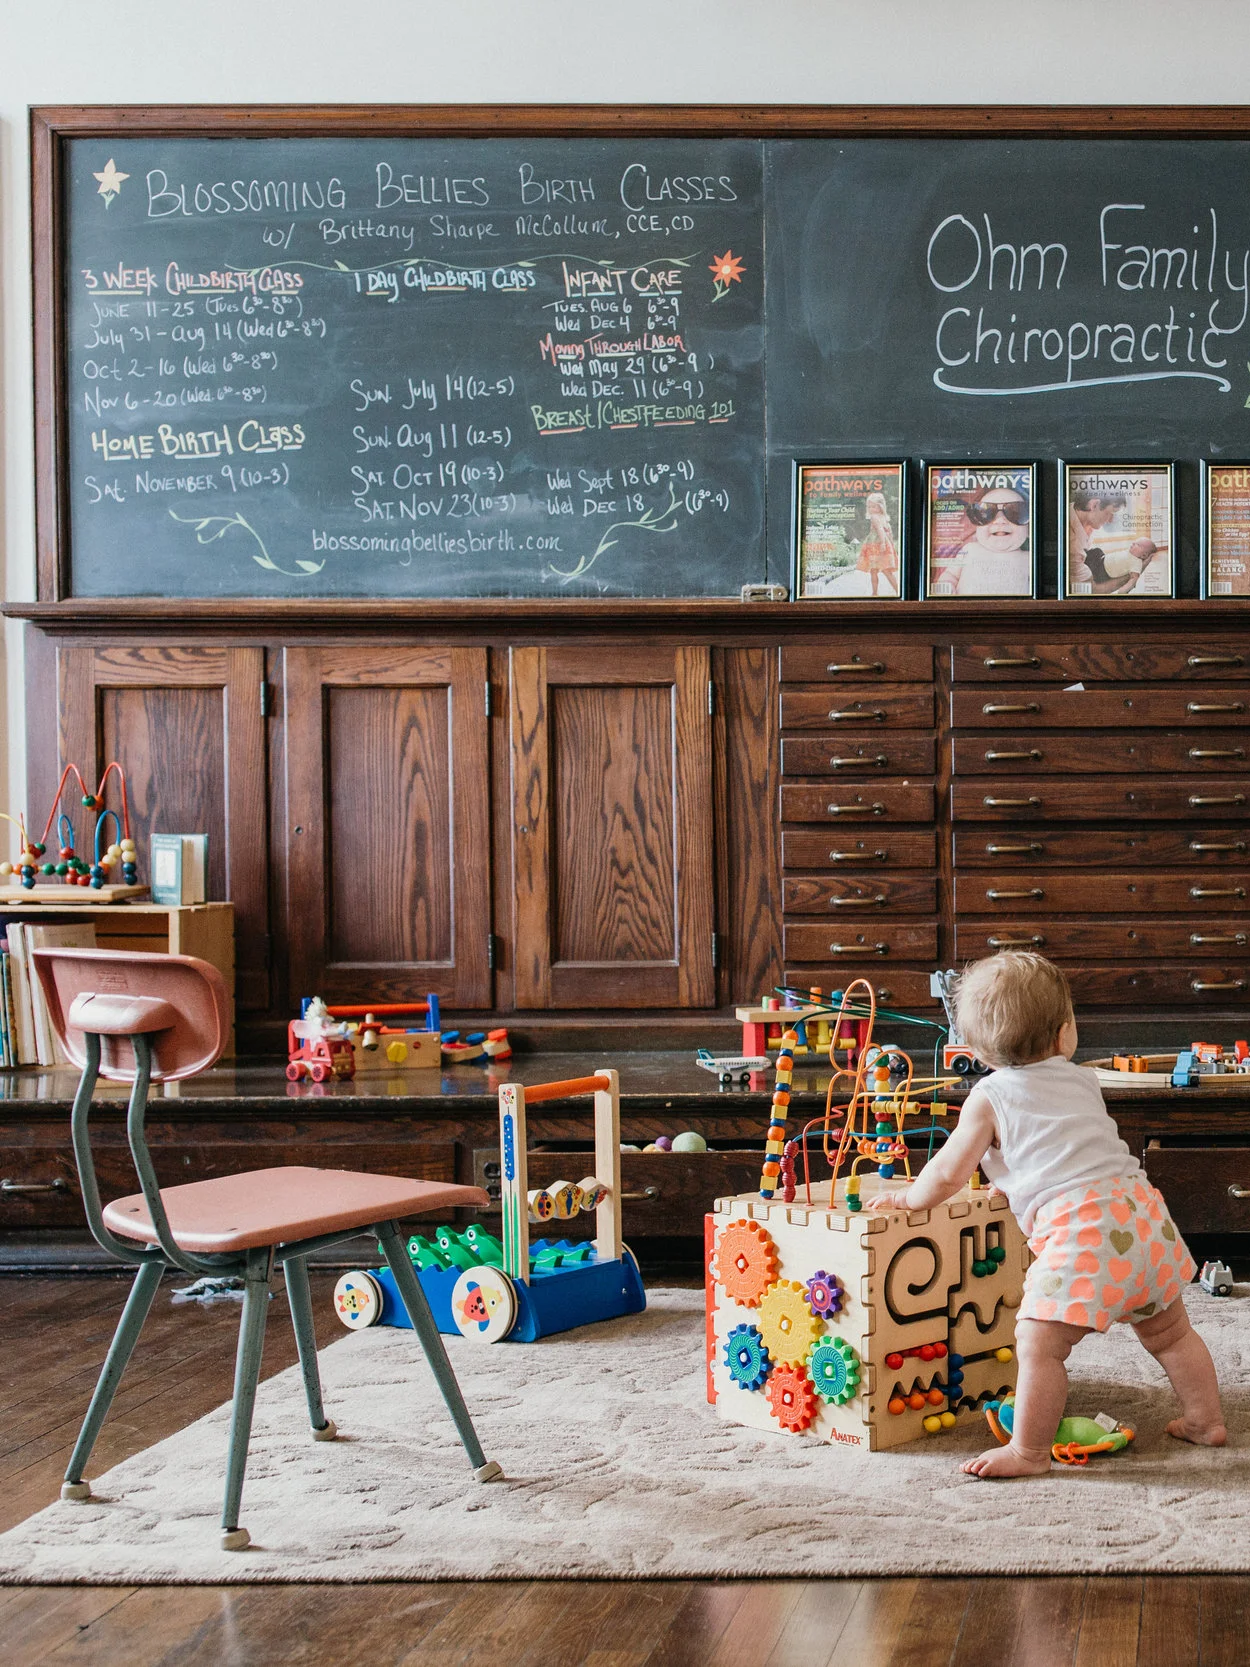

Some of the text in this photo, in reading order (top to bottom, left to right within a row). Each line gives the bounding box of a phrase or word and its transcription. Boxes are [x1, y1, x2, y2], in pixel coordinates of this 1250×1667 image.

[146, 162, 738, 217] BLOSSOMING BELLIES BIRTH CLASSES
[262, 222, 295, 249] w/
[319, 218, 414, 251] Brittany
[431, 213, 500, 248] Sharpe
[81, 261, 304, 297] 3 WEEK CHILDBIRTH CLASS
[562, 261, 682, 297] INFANT CARE
[926, 203, 1250, 335] Ohm Family
[354, 267, 536, 303] 1 DAY CHILDBIRTH CLASS
[621, 297, 633, 314] 6
[554, 315, 581, 332] Wed
[590, 316, 617, 330] DEC
[619, 315, 631, 333] 4
[583, 332, 642, 356] THROUGH
[643, 332, 687, 354] LABOR
[935, 305, 1229, 383] Chiropractic
[83, 360, 122, 380] Oct
[559, 361, 585, 379] Wed
[588, 359, 619, 380] May
[625, 356, 646, 375] 29
[84, 386, 118, 417] Nov
[402, 377, 438, 411] July
[560, 381, 588, 398] Wed
[632, 379, 648, 399] 11
[708, 400, 737, 420] 101
[157, 423, 234, 459] BIRTH
[135, 470, 218, 494] NOVEMBER
[221, 464, 237, 492] 9
[240, 462, 290, 486] (10-3)
[439, 460, 457, 488] 19
[547, 468, 572, 491] Wed
[577, 467, 614, 494] Sept
[621, 467, 640, 488] 18
[547, 493, 574, 516] Wed
[583, 498, 617, 517] DEC
[626, 493, 645, 514] 18
